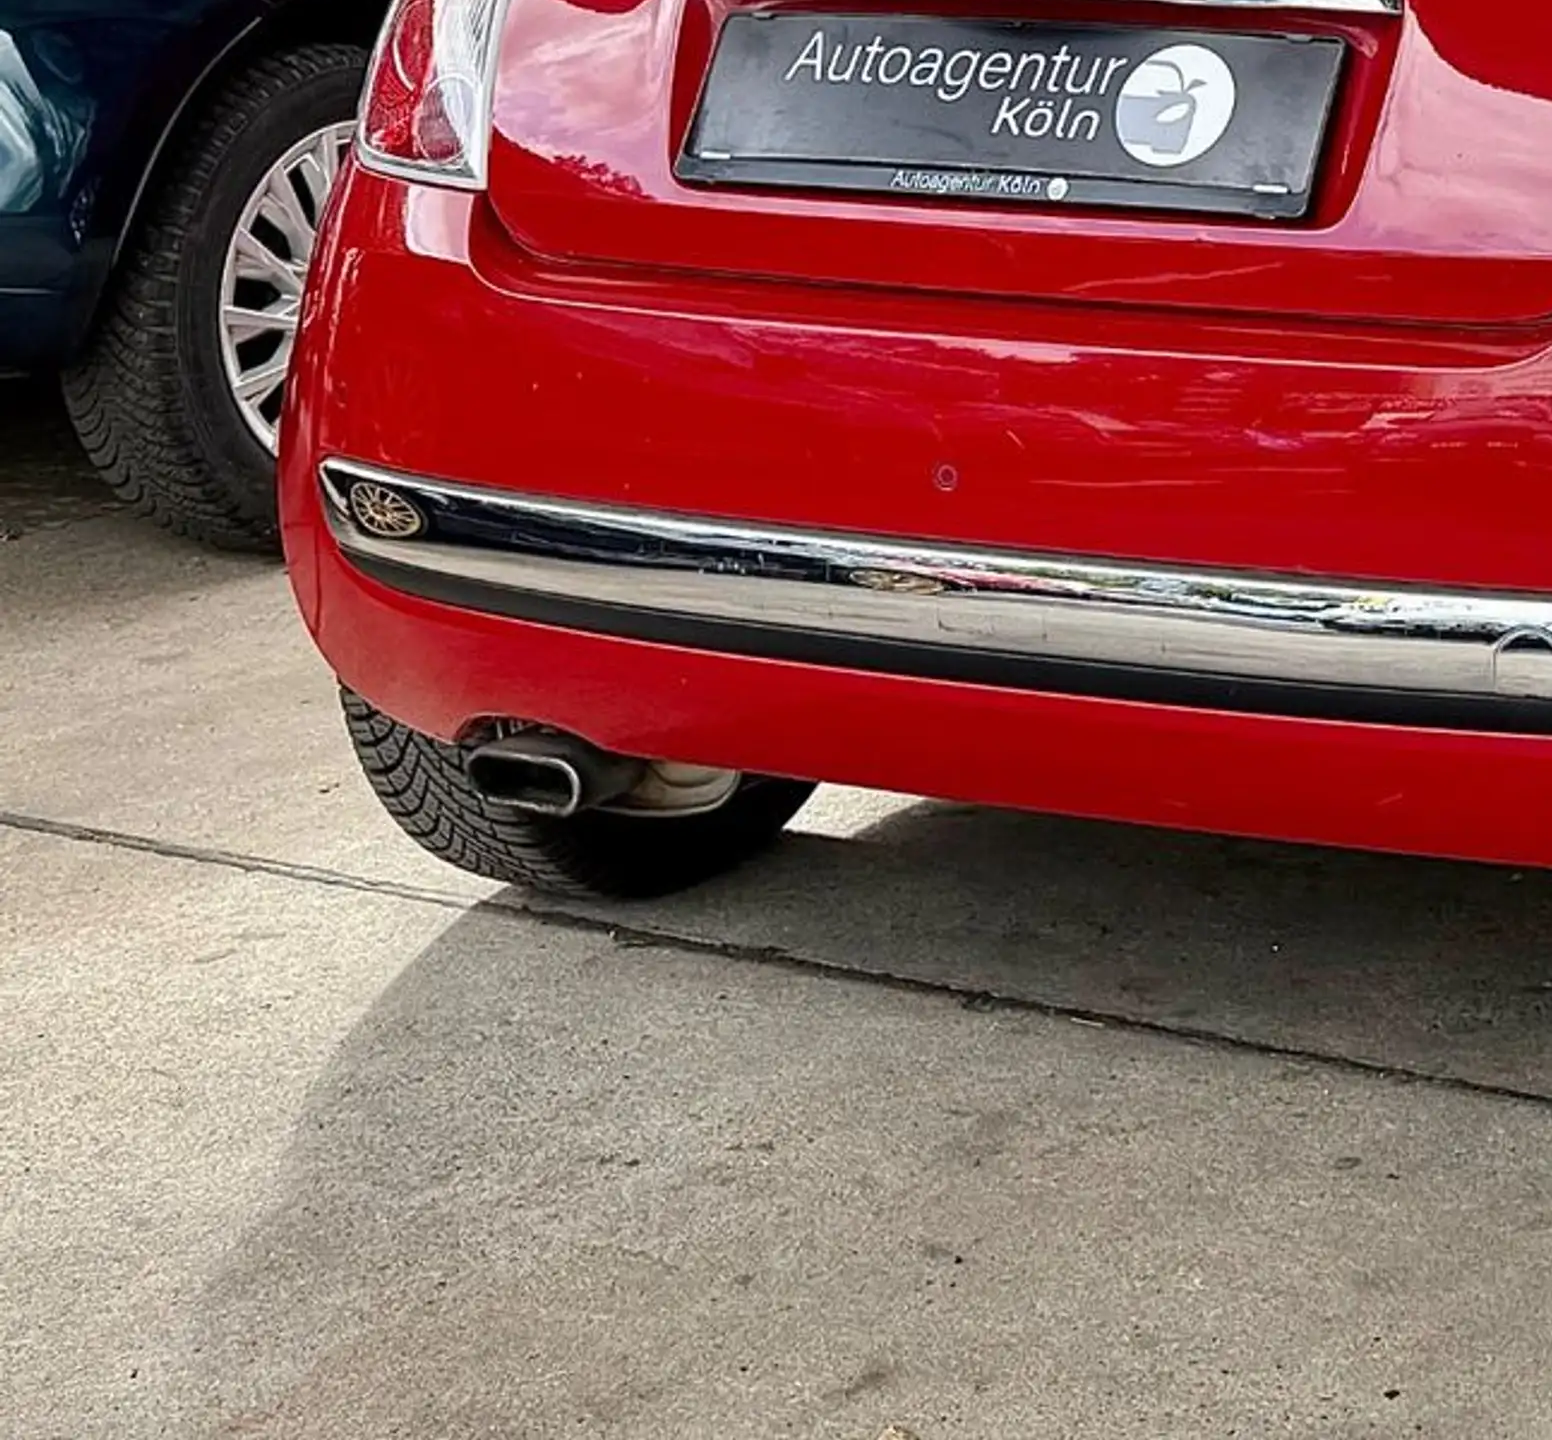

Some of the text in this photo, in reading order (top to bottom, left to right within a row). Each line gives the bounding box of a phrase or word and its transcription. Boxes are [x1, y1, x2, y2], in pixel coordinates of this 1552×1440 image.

[785, 30, 1127, 102] Autoagentur
[991, 97, 1101, 142] Köln
[890, 170, 1041, 194] Autoagentur Köln
